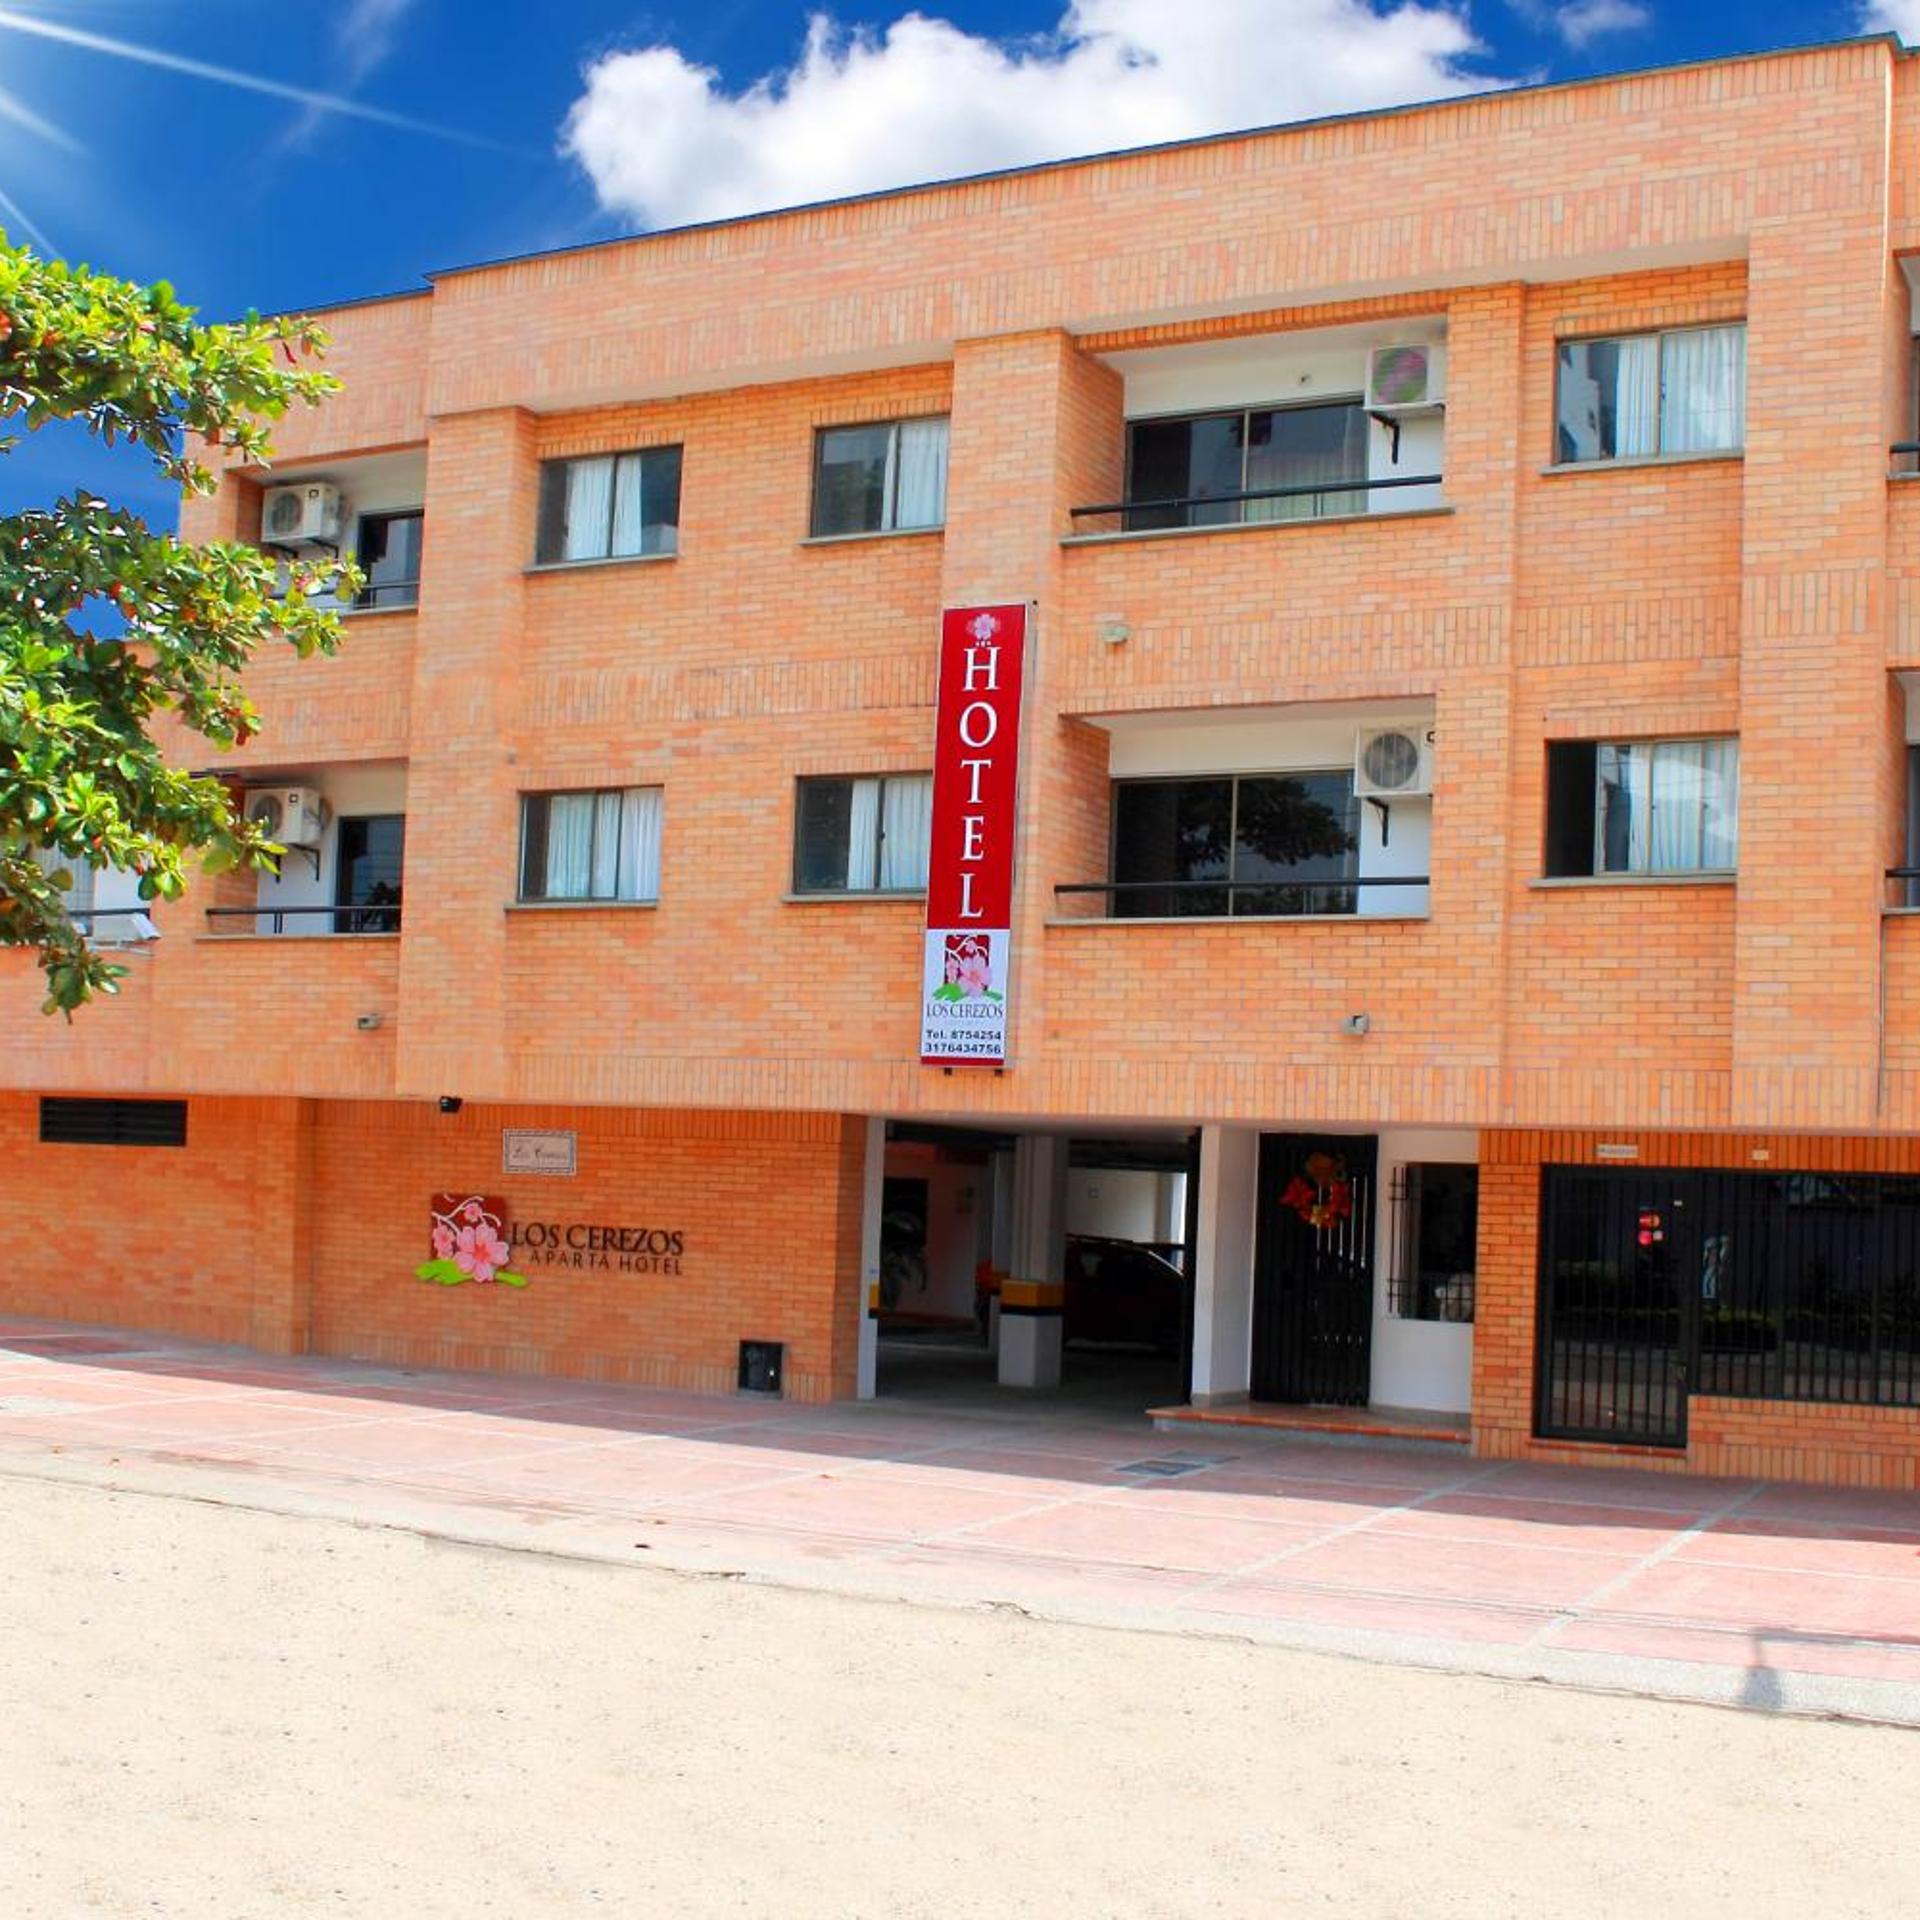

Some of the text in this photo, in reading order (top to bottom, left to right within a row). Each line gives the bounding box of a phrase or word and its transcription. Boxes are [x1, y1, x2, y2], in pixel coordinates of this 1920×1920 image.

[959, 646, 1002, 919] HOTEL
[927, 1003, 1004, 1019] LOS CEREZOS
[926, 1029, 946, 1040] Tel.
[511, 1222, 684, 1256] LOS CEREZOS
[529, 1250, 683, 1276] APARTA HOTEL
